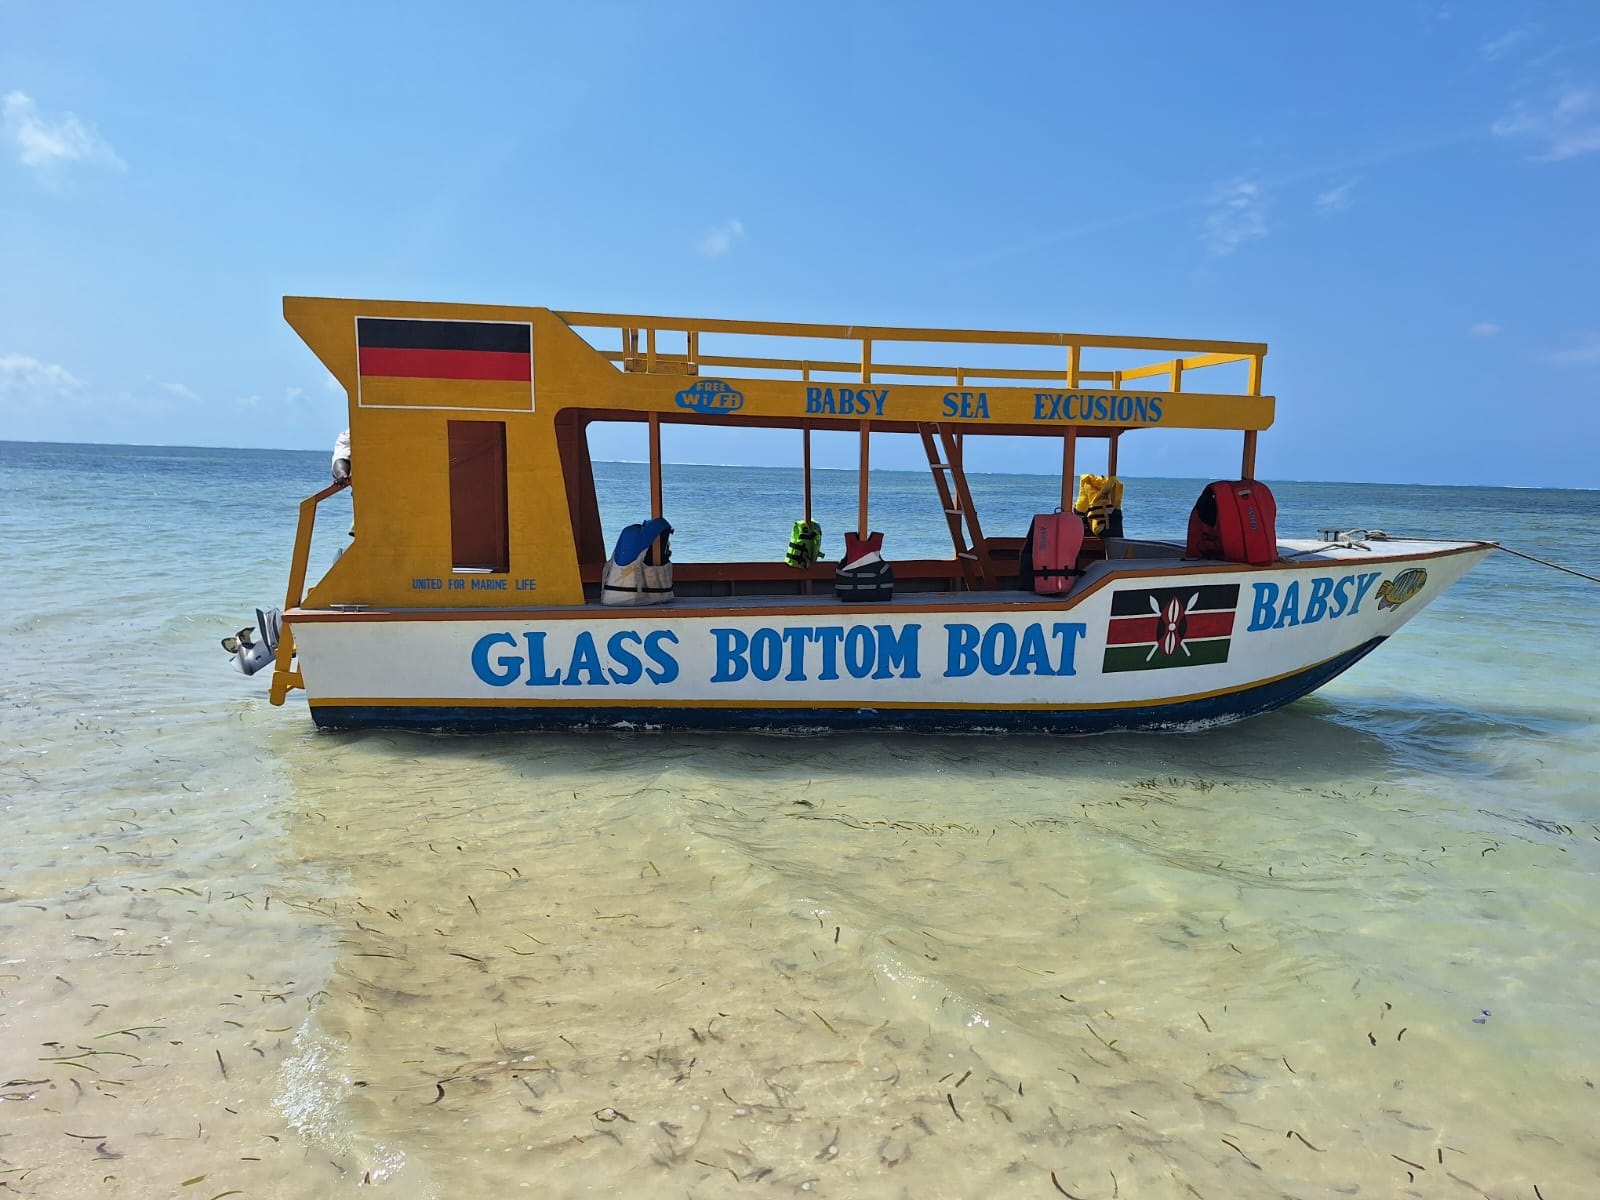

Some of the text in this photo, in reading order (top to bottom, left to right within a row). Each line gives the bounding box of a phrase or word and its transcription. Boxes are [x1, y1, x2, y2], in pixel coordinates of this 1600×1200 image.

[696, 382, 726, 392] FREE
[806, 387, 1163, 422] BABSY SEA EXCUSIONS
[412, 578, 536, 591] UNITED FOR MARINE LIFE
[1246, 571, 1382, 633] BABSY
[470, 621, 1087, 687] GLASS BOTTOM BOAT
